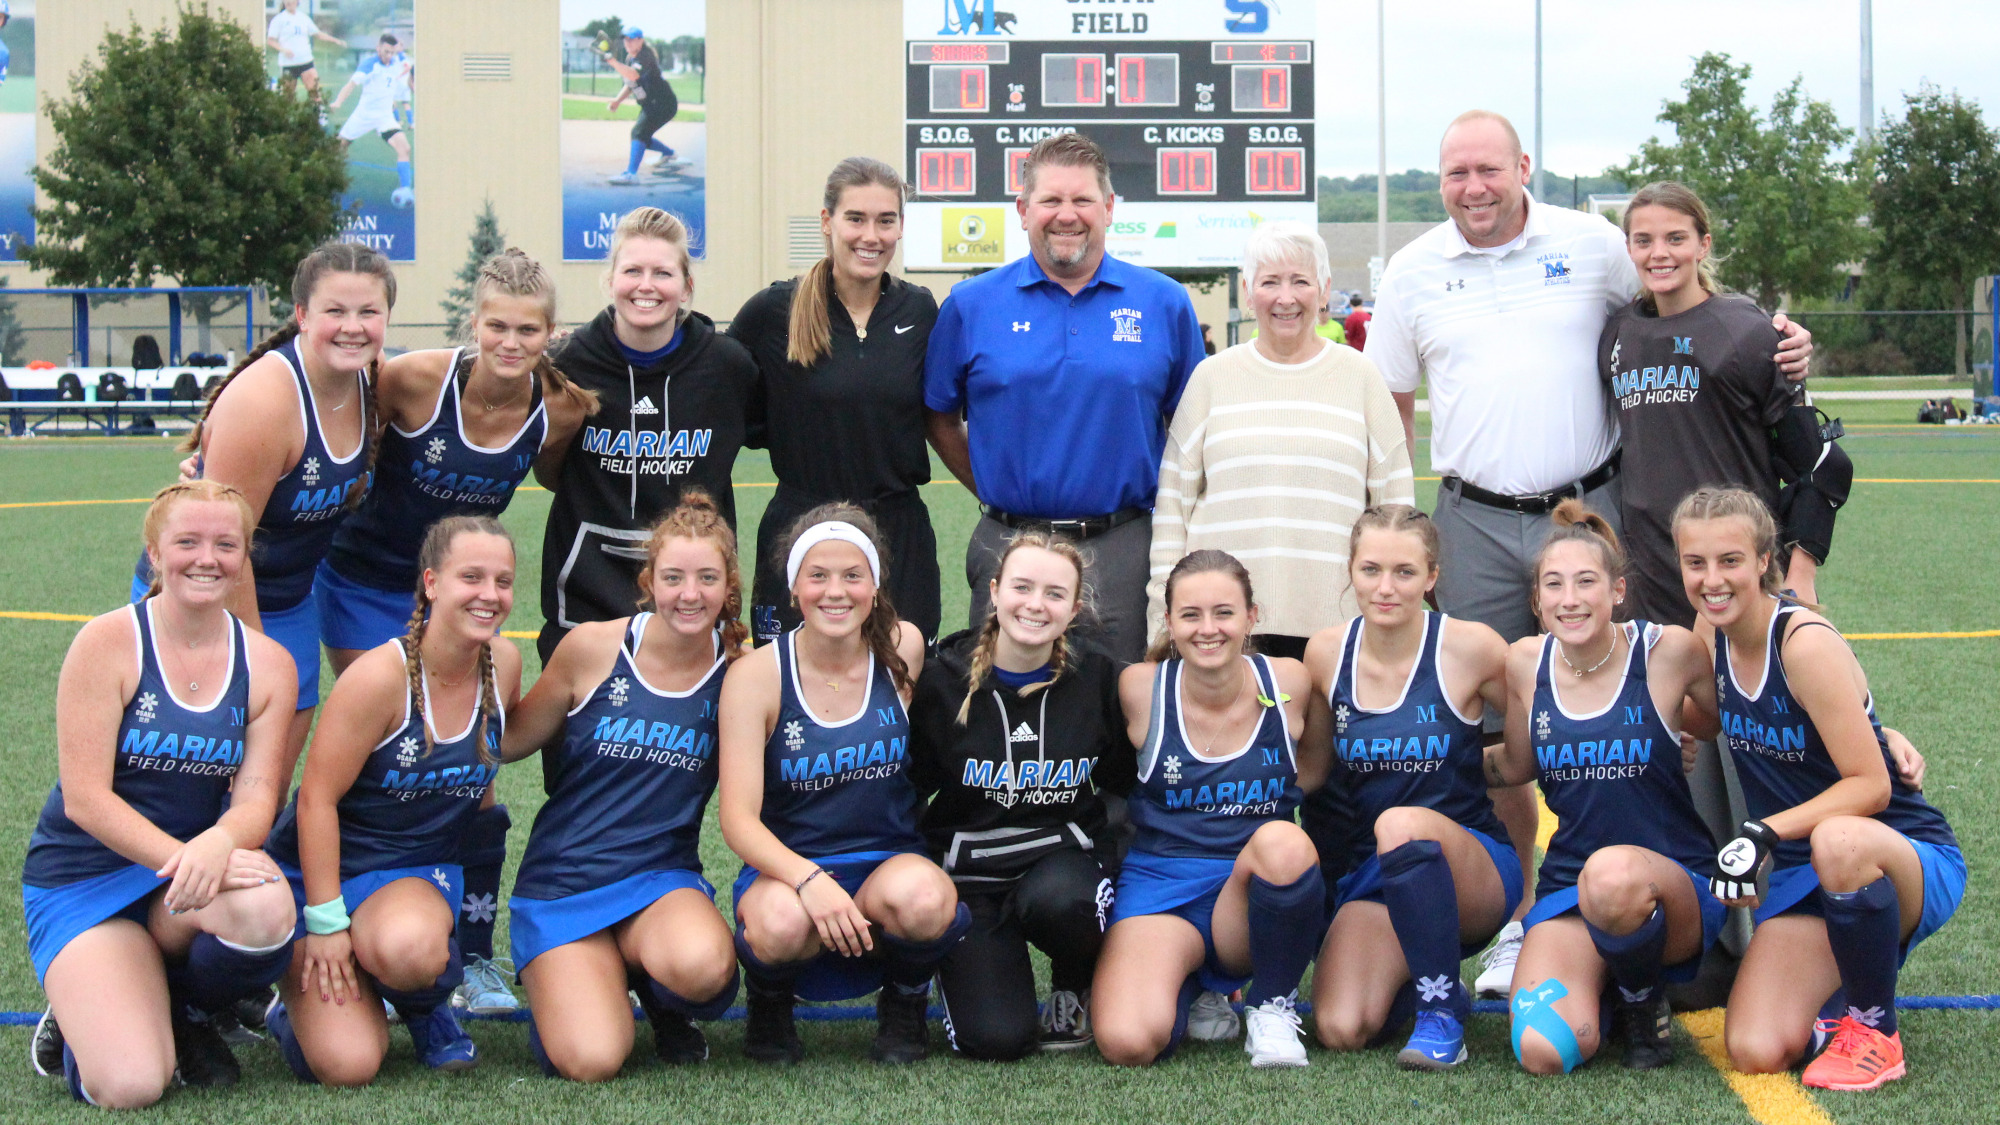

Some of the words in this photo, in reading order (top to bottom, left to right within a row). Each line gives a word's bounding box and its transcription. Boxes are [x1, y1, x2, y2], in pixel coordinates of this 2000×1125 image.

[1072, 13, 1148, 34] FIELD
[961, 69, 985, 109] 0
[1008, 83, 1025, 92] 1st
[1195, 83, 1215, 92] 2nd
[1262, 68, 1287, 109] 0
[1006, 103, 1026, 112] Half
[1195, 103, 1215, 112] Half
[920, 127, 975, 143] S.O.G.
[996, 127, 1015, 143] C.
[1144, 127, 1162, 143] C.
[1166, 127, 1225, 143] KICKS
[1249, 127, 1302, 143] S.O.G.
[921, 152, 972, 192] 00
[1162, 152, 1213, 191] 00
[1251, 152, 1301, 191] 00
[1537, 253, 1570, 264] MARIAN
[1543, 261, 1567, 278] M
[1110, 308, 1142, 319] MARIAN
[1114, 317, 1137, 335] M
[1112, 334, 1142, 343] SOFTBALL
[1673, 336, 1693, 355] M
[1612, 365, 1700, 399] MARIAN
[1645, 389, 1699, 404] HOCKEY
[582, 426, 713, 458] MARIAN
[600, 458, 634, 475] FIELD
[639, 460, 694, 475] HOCKEY
[412, 477, 453, 500] FIELD
[293, 508, 340, 522] FIELD
[609, 694, 629, 702] OSAKA
[1770, 695, 1791, 714] M
[136, 709, 156, 719] OSAKA
[876, 706, 898, 727] M
[1416, 704, 1439, 724] M
[1623, 705, 1645, 725] M
[593, 716, 717, 760] MARIAN
[1009, 733, 1039, 743] adidas
[1719, 708, 1806, 751] MARIAN
[785, 738, 805, 746] OSAKA
[1332, 734, 1451, 761] MARIAN
[396, 754, 417, 763] OSAKA
[597, 742, 643, 759] FIELD
[645, 749, 706, 773] HOCKEY
[780, 736, 907, 782] MARIAN
[1261, 747, 1281, 766] M
[1536, 738, 1653, 771] MARIAN
[1753, 742, 1806, 762] HOCKEY
[128, 755, 177, 772] FIELD
[1380, 759, 1445, 773] HOCKEY
[791, 777, 834, 792] FIELD
[840, 762, 901, 784] HOCKEY
[962, 756, 1099, 790] MARIAN
[1545, 768, 1580, 782] FIELD
[1585, 764, 1648, 780] HOCKEY
[1022, 789, 1078, 805] HOCKEY
[1165, 777, 1286, 809] MARIAN
[1219, 800, 1279, 817] HOCKEY
